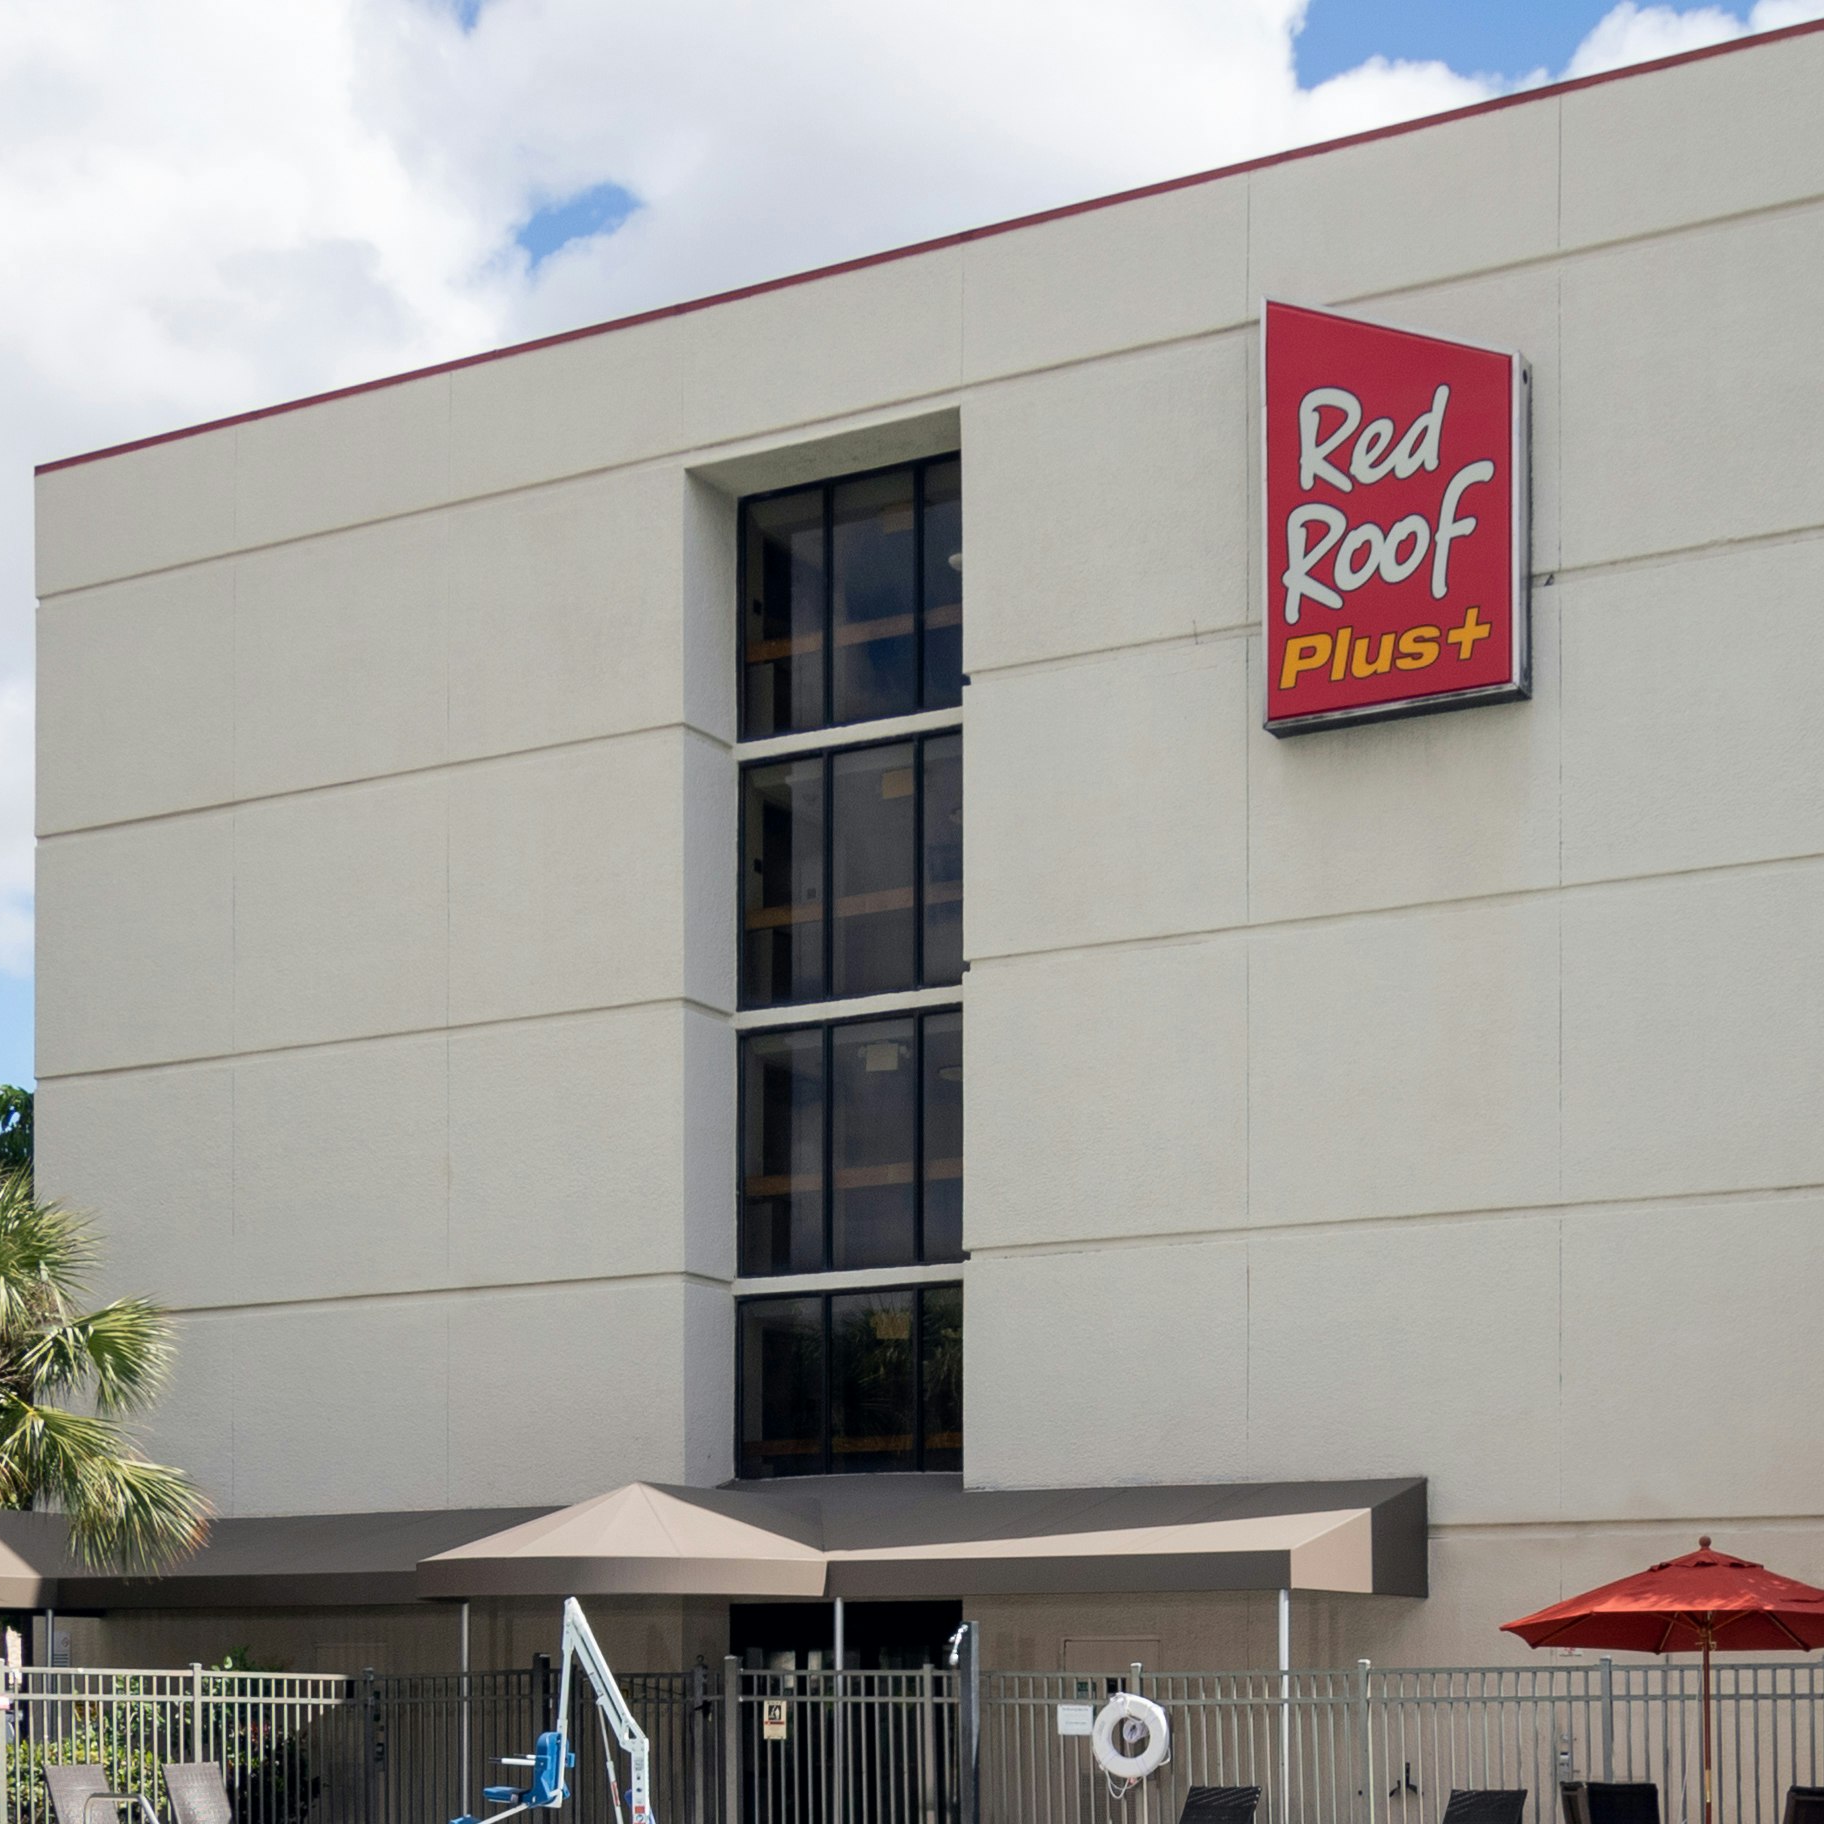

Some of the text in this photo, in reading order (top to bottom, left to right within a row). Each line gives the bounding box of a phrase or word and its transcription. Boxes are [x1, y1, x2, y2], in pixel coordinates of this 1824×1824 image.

[1299, 384, 1450, 493] Red
[1281, 459, 1495, 624] Roof
[1278, 606, 1492, 691] Plus+
